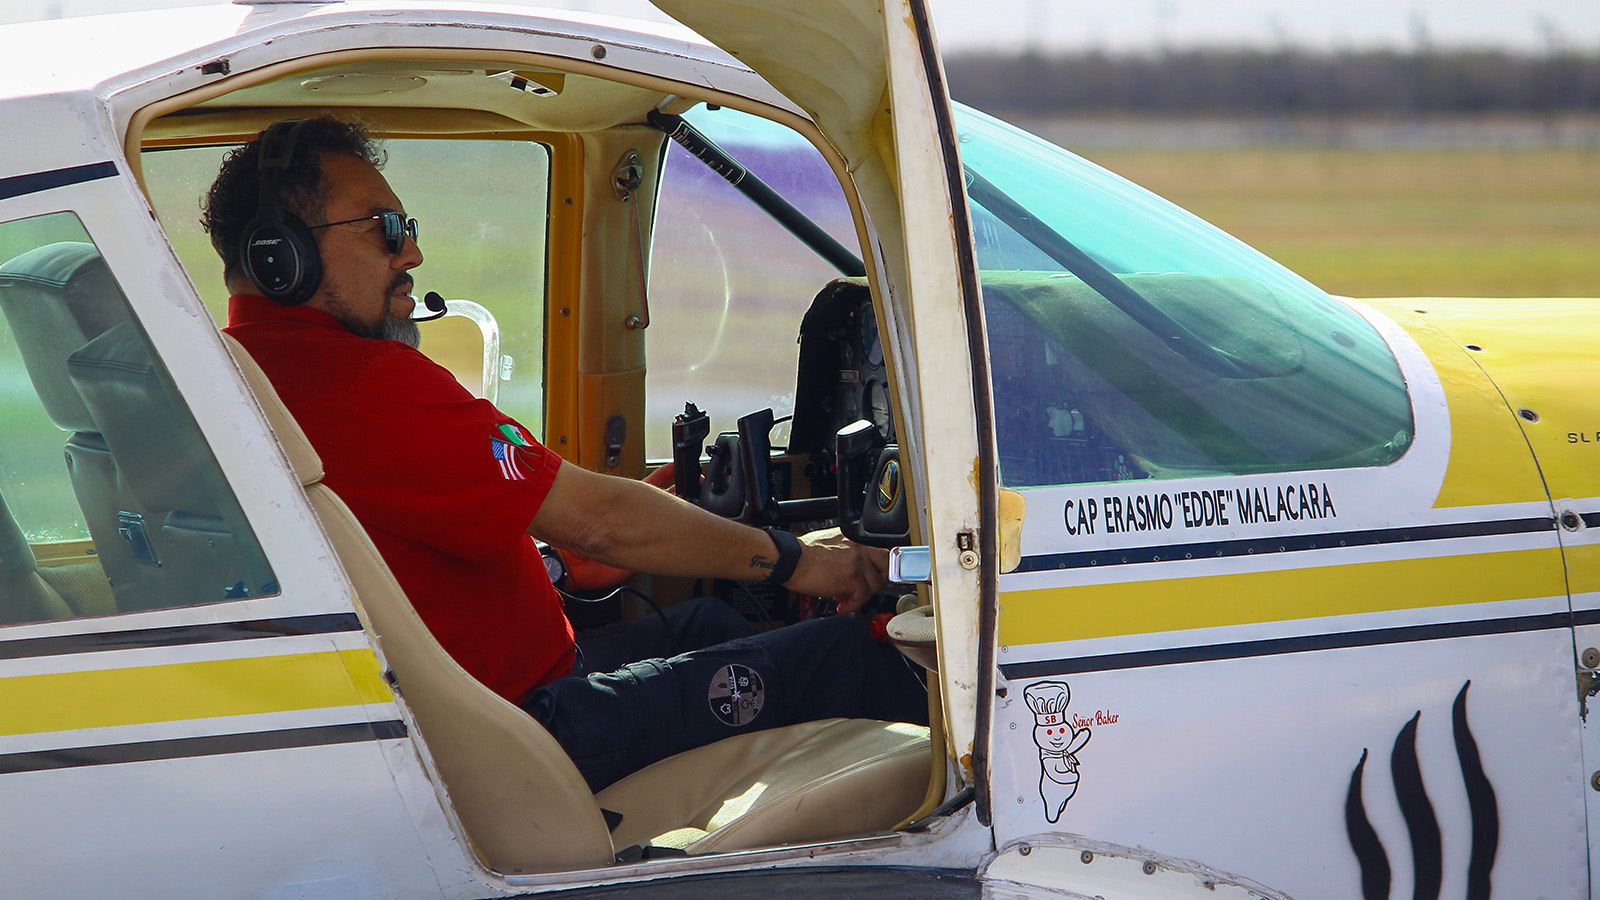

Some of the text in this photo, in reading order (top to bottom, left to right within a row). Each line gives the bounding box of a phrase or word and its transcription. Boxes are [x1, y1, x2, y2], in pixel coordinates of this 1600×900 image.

[1064, 482, 1337, 536] CAP ERASMO "EDDIE" MALACARA
[1045, 715, 1057, 724] SB
[1095, 709, 1119, 726] Baker
